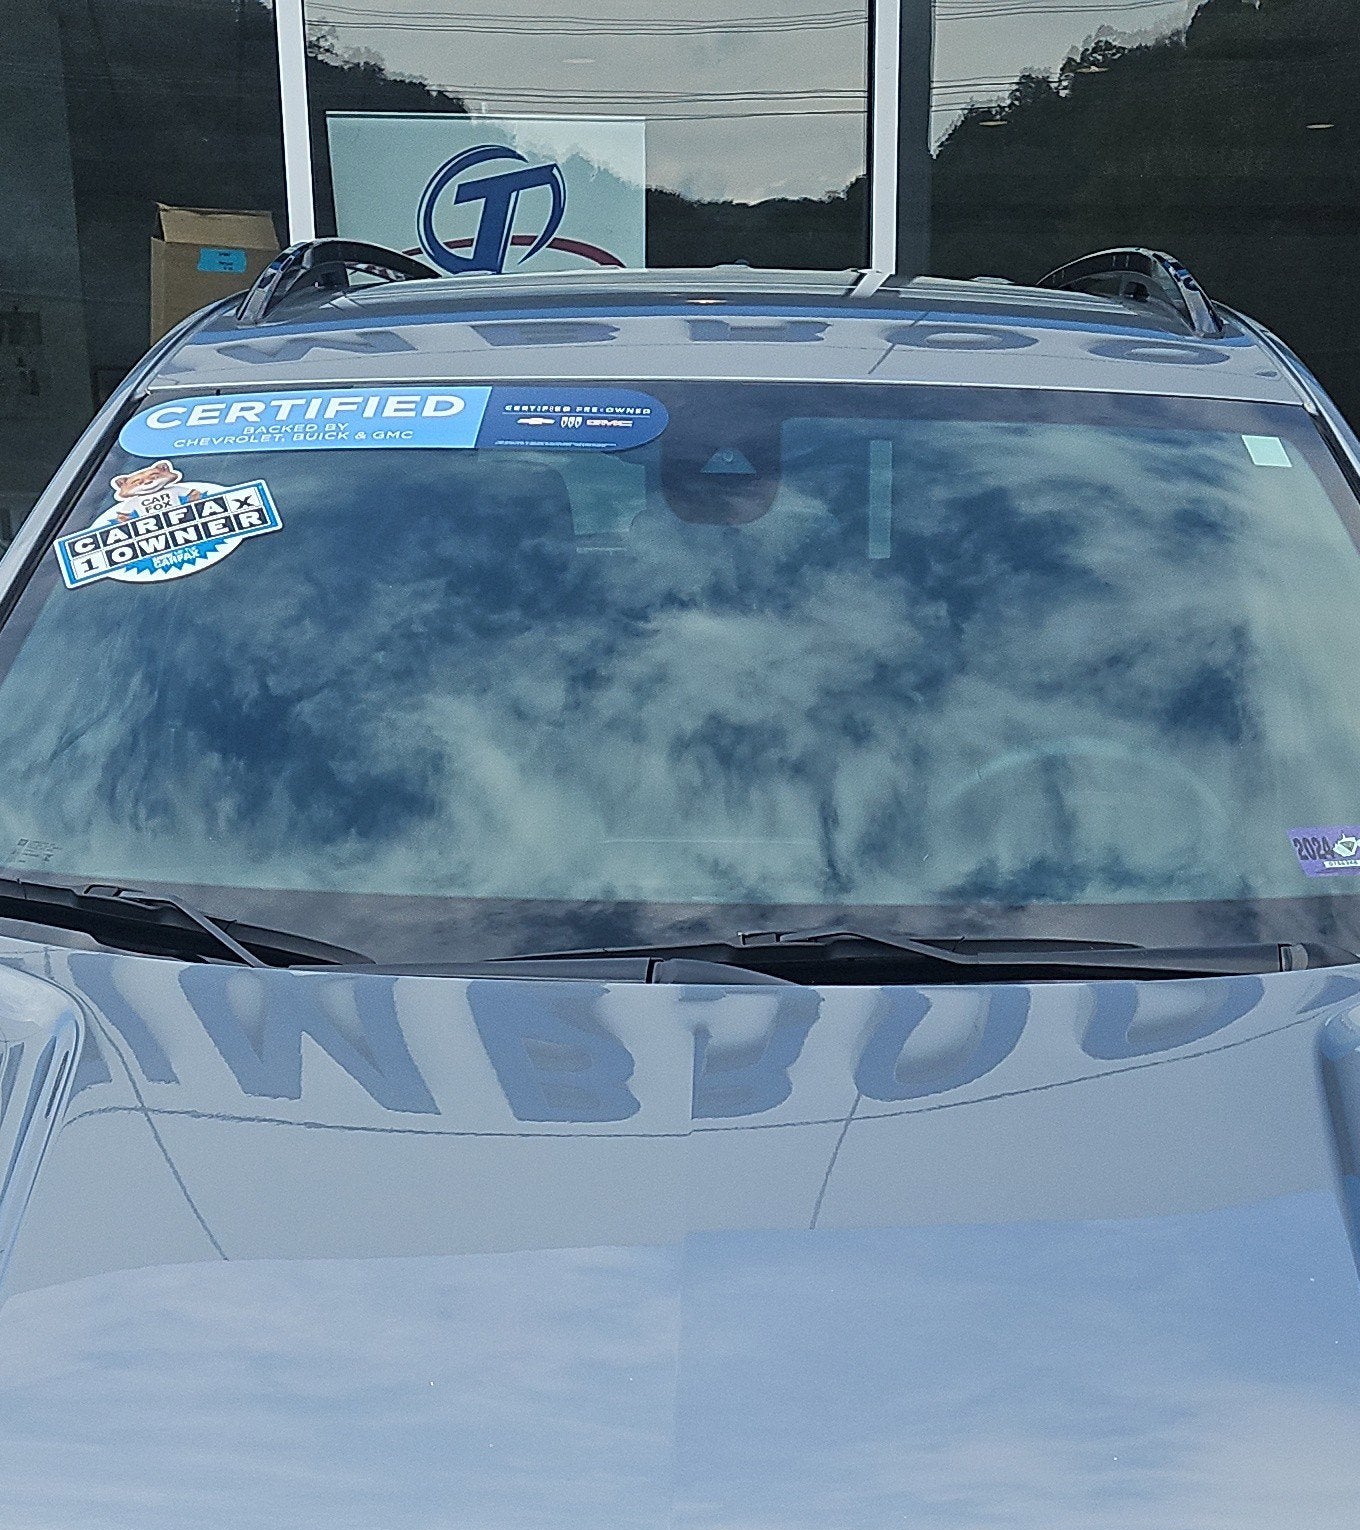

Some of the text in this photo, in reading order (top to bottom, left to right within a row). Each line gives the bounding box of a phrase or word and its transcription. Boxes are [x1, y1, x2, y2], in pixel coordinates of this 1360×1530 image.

[146, 395, 465, 430] CERTIFIED
[243, 423, 349, 434] BACKED BY
[293, 431, 349, 442] BUICK
[354, 431, 367, 440] &
[372, 430, 414, 440] GMC
[140, 493, 171, 508] CAR
[144, 500, 173, 513] FOX
[73, 494, 254, 552] CARFAX
[81, 559, 100, 573] 1
[112, 511, 262, 561] OWNER
[1293, 836, 1336, 861] 2024
